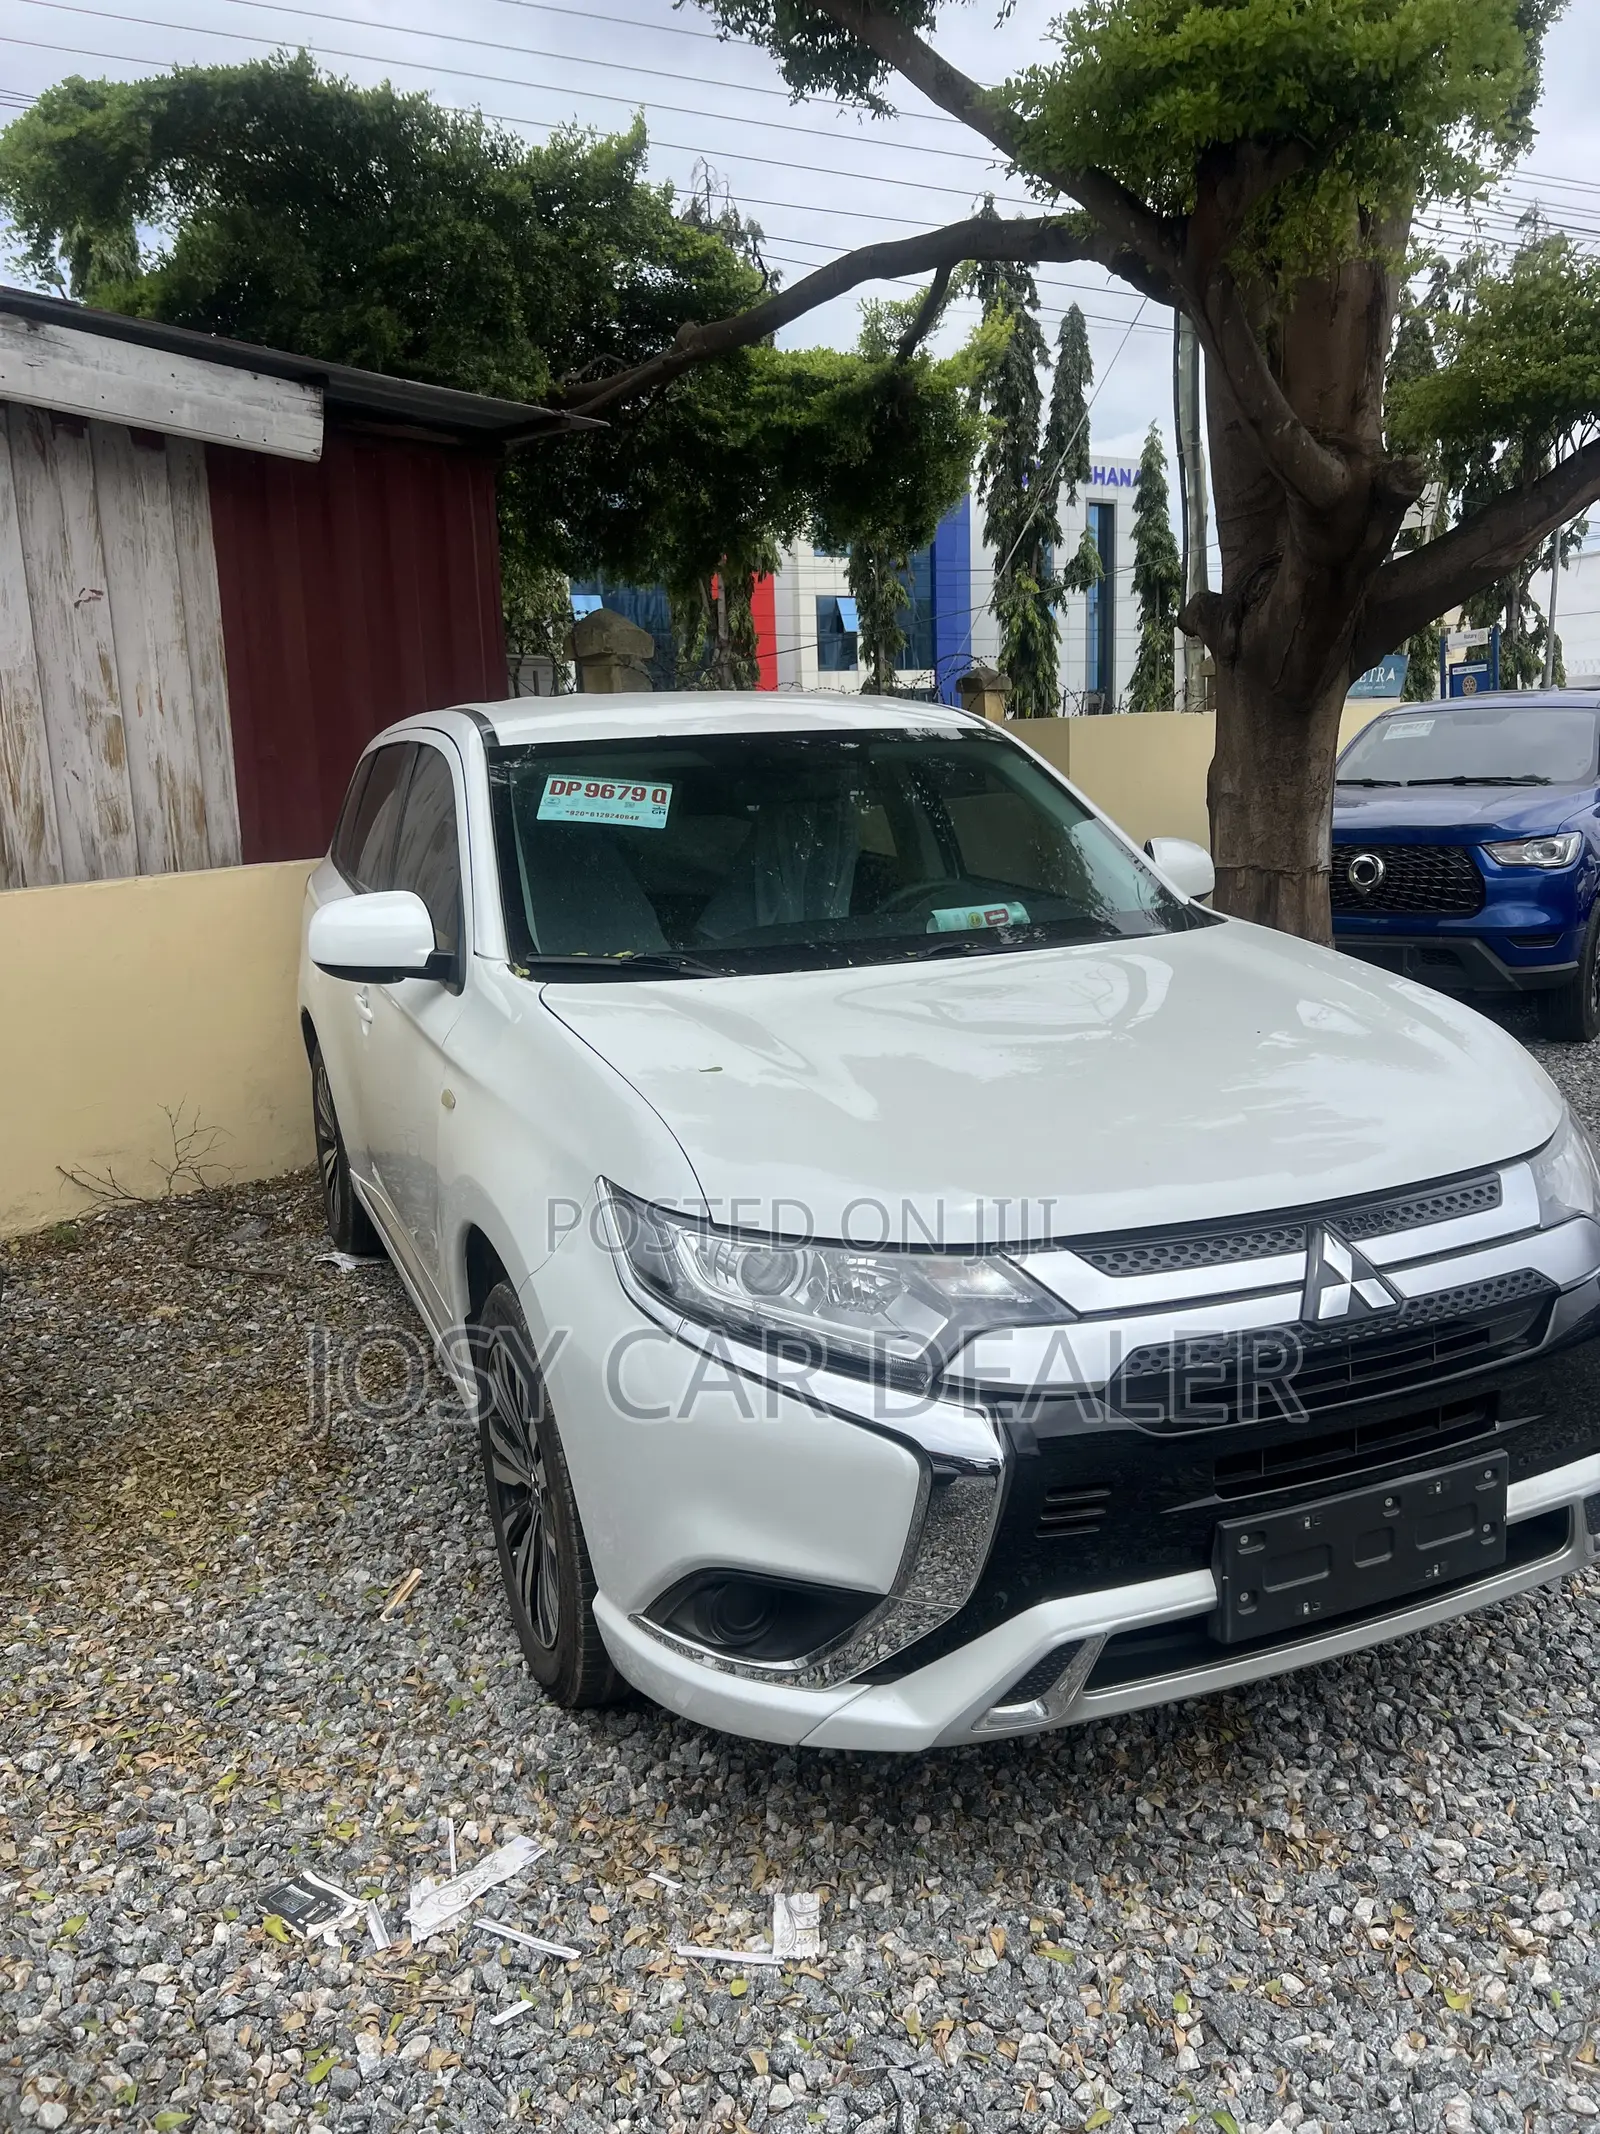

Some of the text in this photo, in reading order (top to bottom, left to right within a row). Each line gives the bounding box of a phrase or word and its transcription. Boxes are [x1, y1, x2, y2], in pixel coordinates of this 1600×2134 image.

[1085, 465, 1142, 487] HANA
[548, 780, 583, 797] DP
[583, 782, 647, 802] 9679
[651, 788, 668, 805] Q
